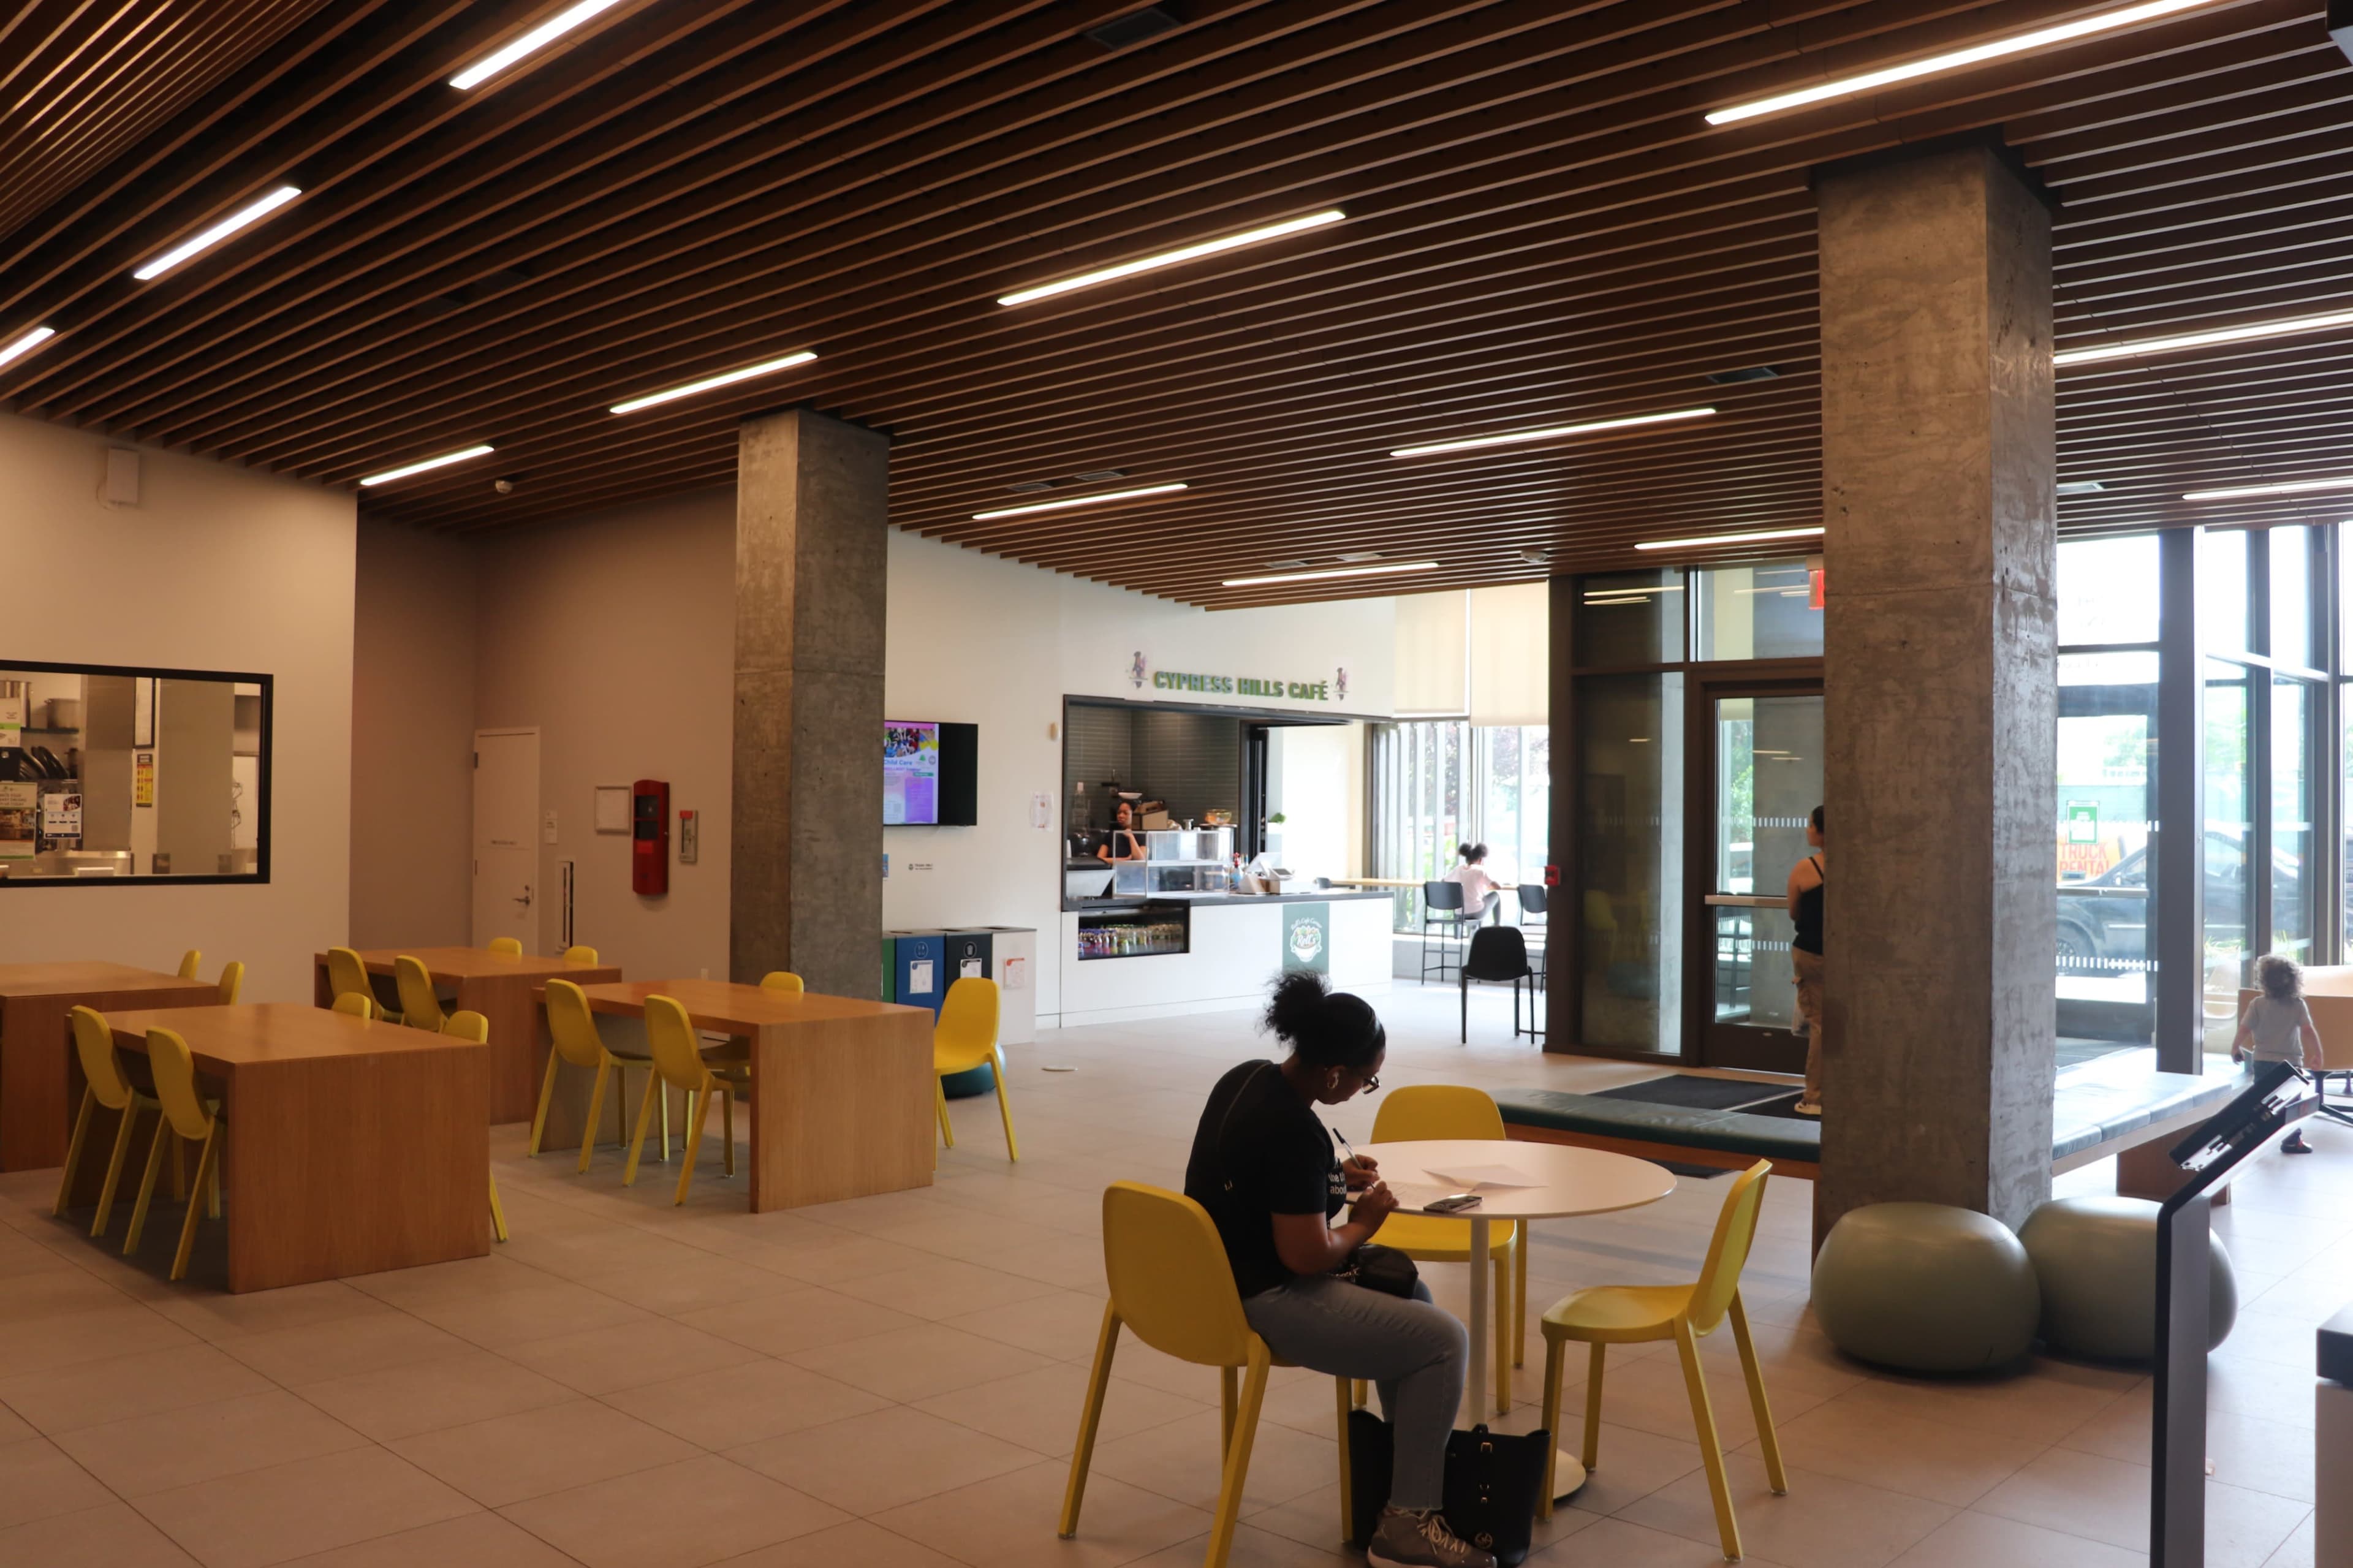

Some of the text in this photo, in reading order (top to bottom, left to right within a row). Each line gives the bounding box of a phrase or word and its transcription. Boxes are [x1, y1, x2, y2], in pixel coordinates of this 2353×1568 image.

[1153, 671, 1328, 700] CYPRESS HILLS CAFÉ
[2059, 843, 2108, 859] TRUCK
